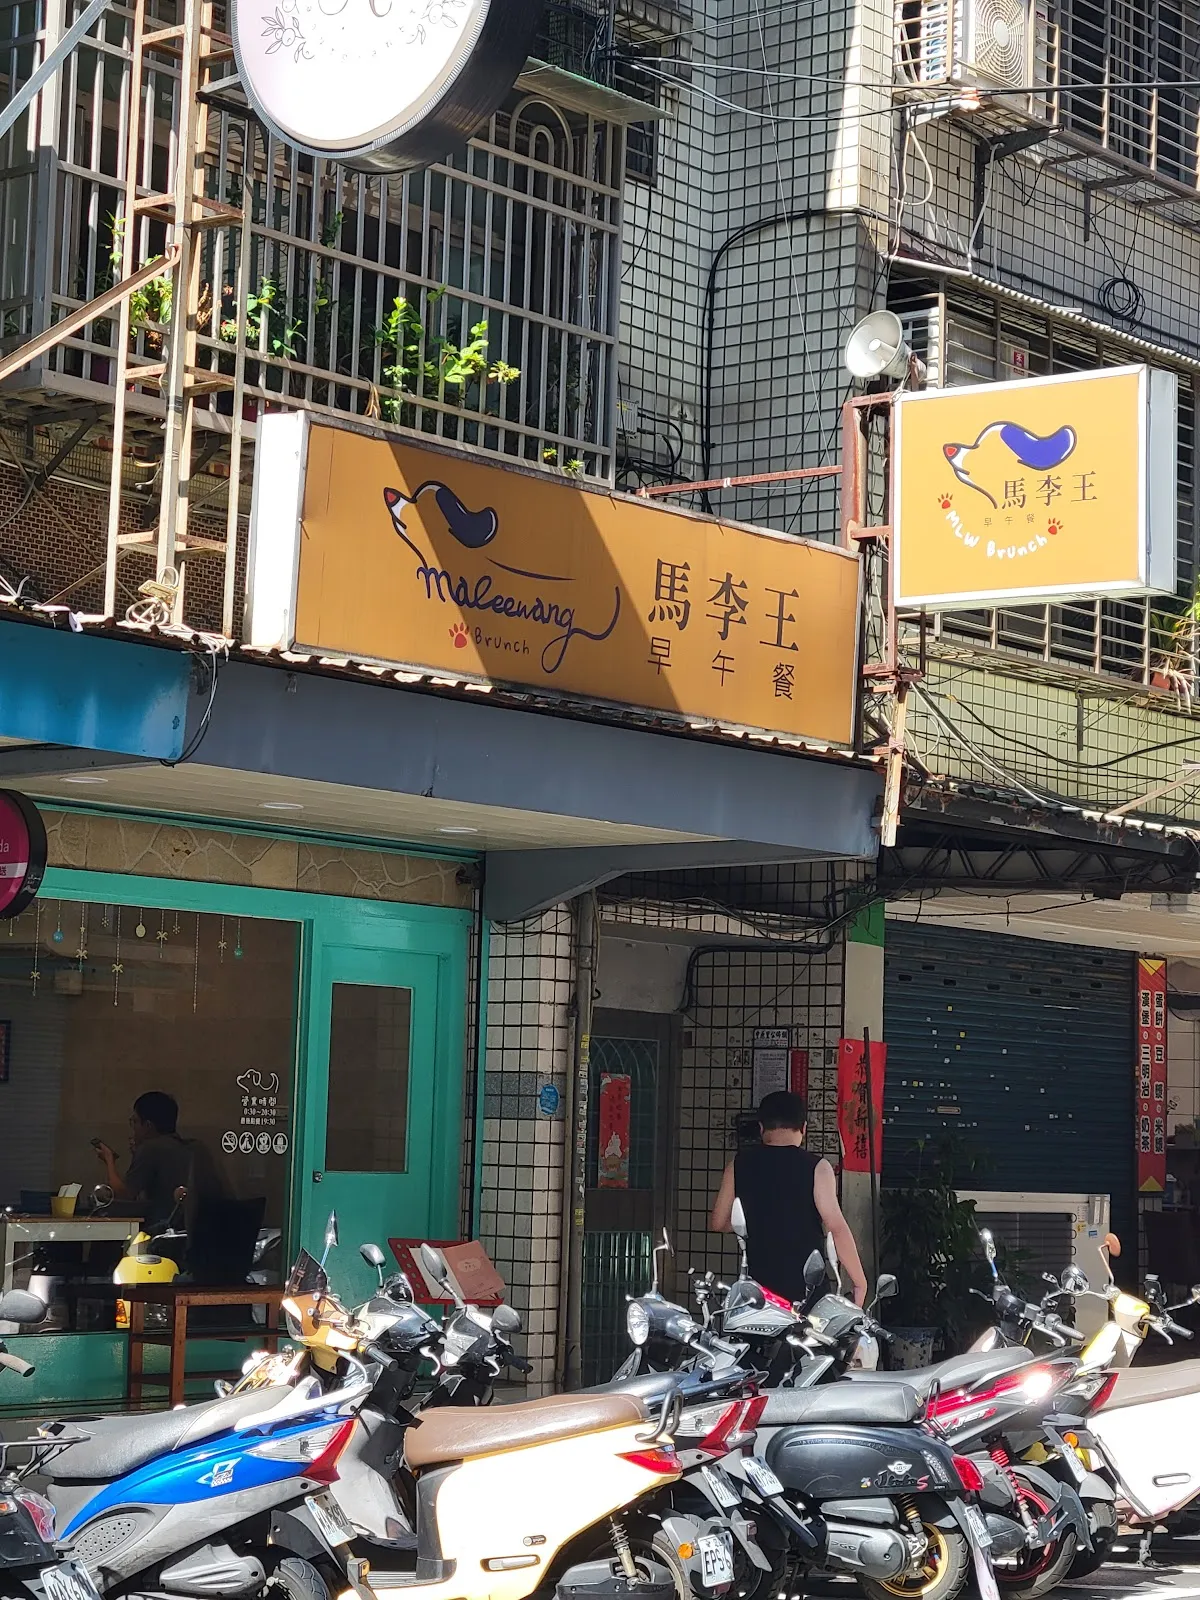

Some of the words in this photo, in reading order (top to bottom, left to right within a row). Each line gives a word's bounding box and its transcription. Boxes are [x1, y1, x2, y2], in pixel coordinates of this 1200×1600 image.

[1001, 470, 1098, 509] 馬李王
[945, 509, 981, 548] MLW
[986, 534, 1048, 560] Brunch
[983, 513, 1035, 527] 早午餐
[647, 558, 800, 652] 馬李王
[647, 636, 795, 701] 早午餐
